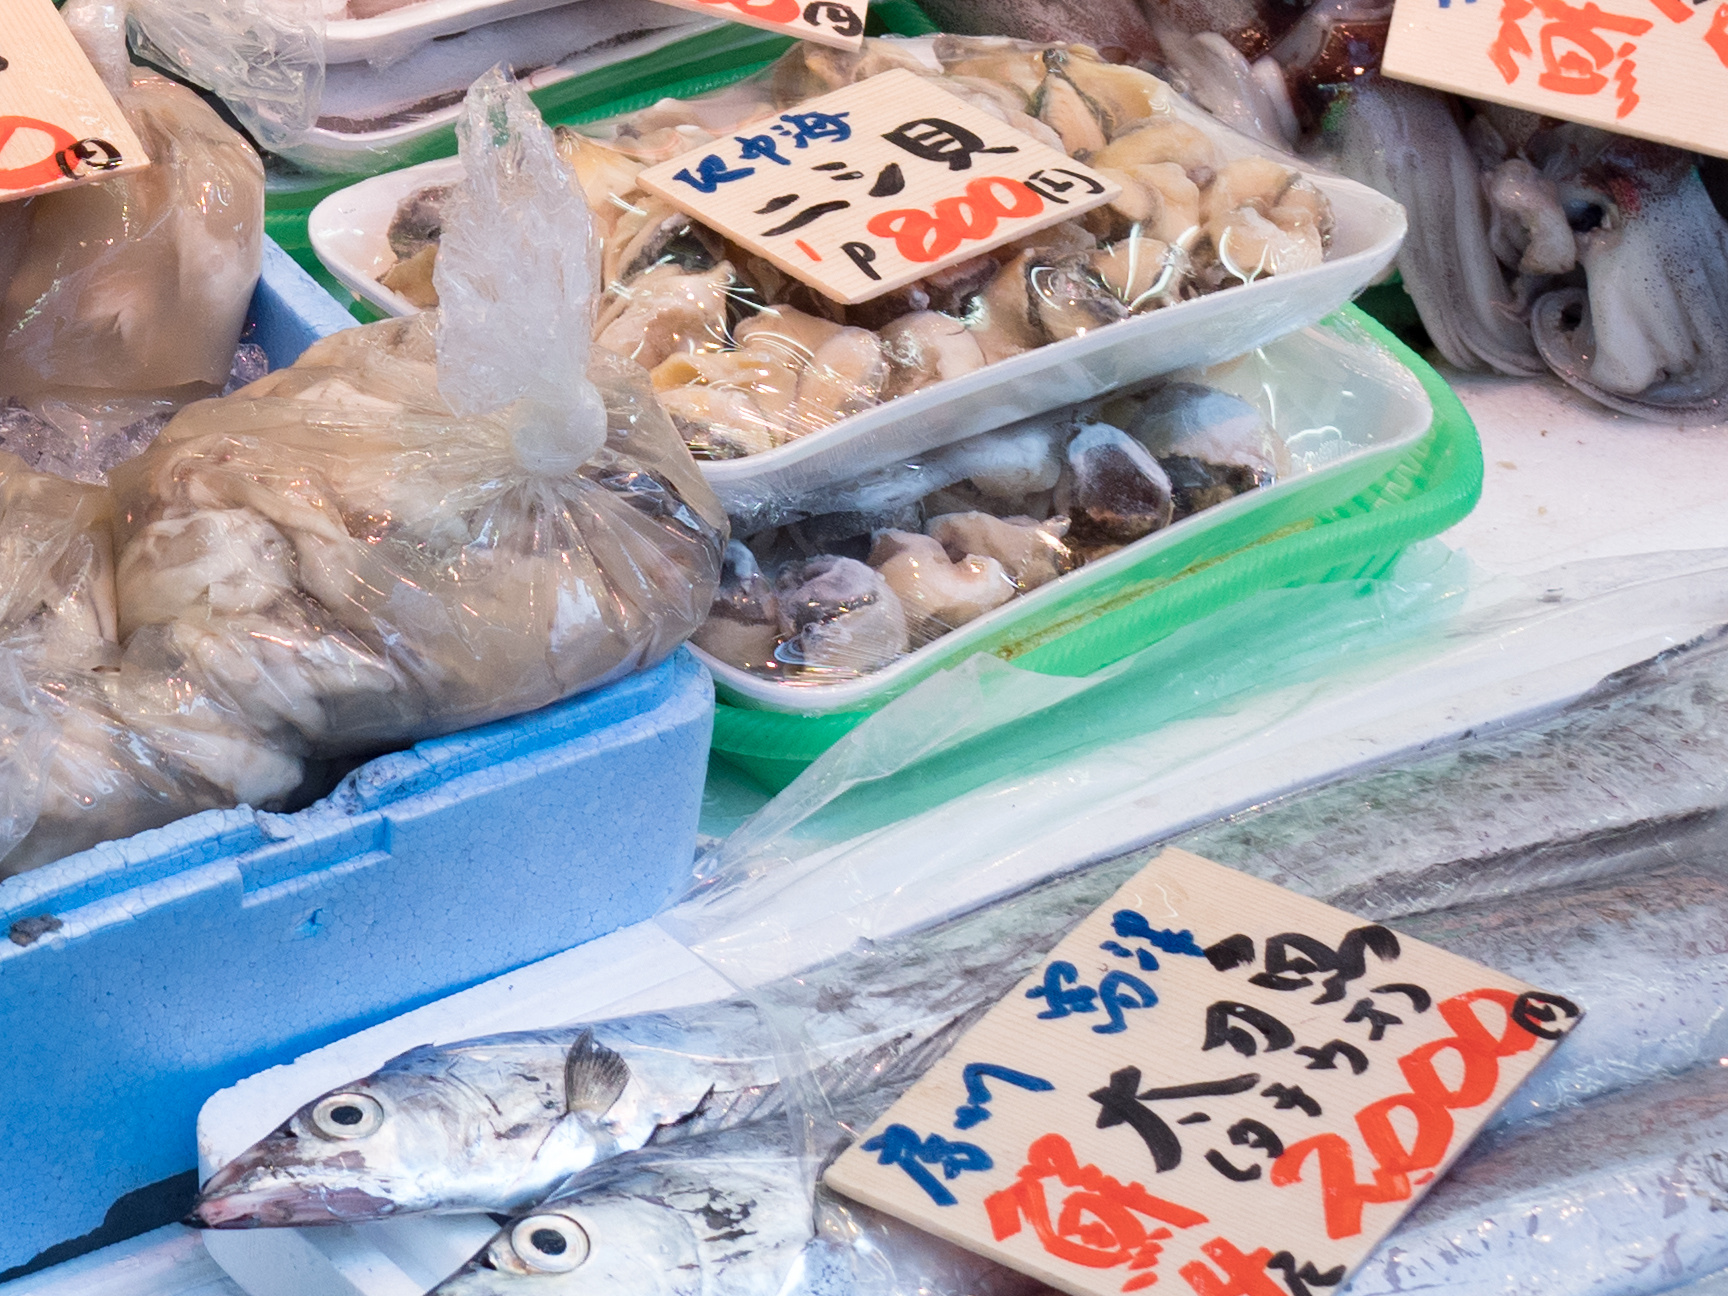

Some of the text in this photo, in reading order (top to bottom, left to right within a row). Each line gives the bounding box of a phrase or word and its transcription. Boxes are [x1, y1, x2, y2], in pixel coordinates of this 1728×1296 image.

[1088, 923, 1402, 1175] 太刀魚
[984, 1133, 1211, 1293] 鮮
